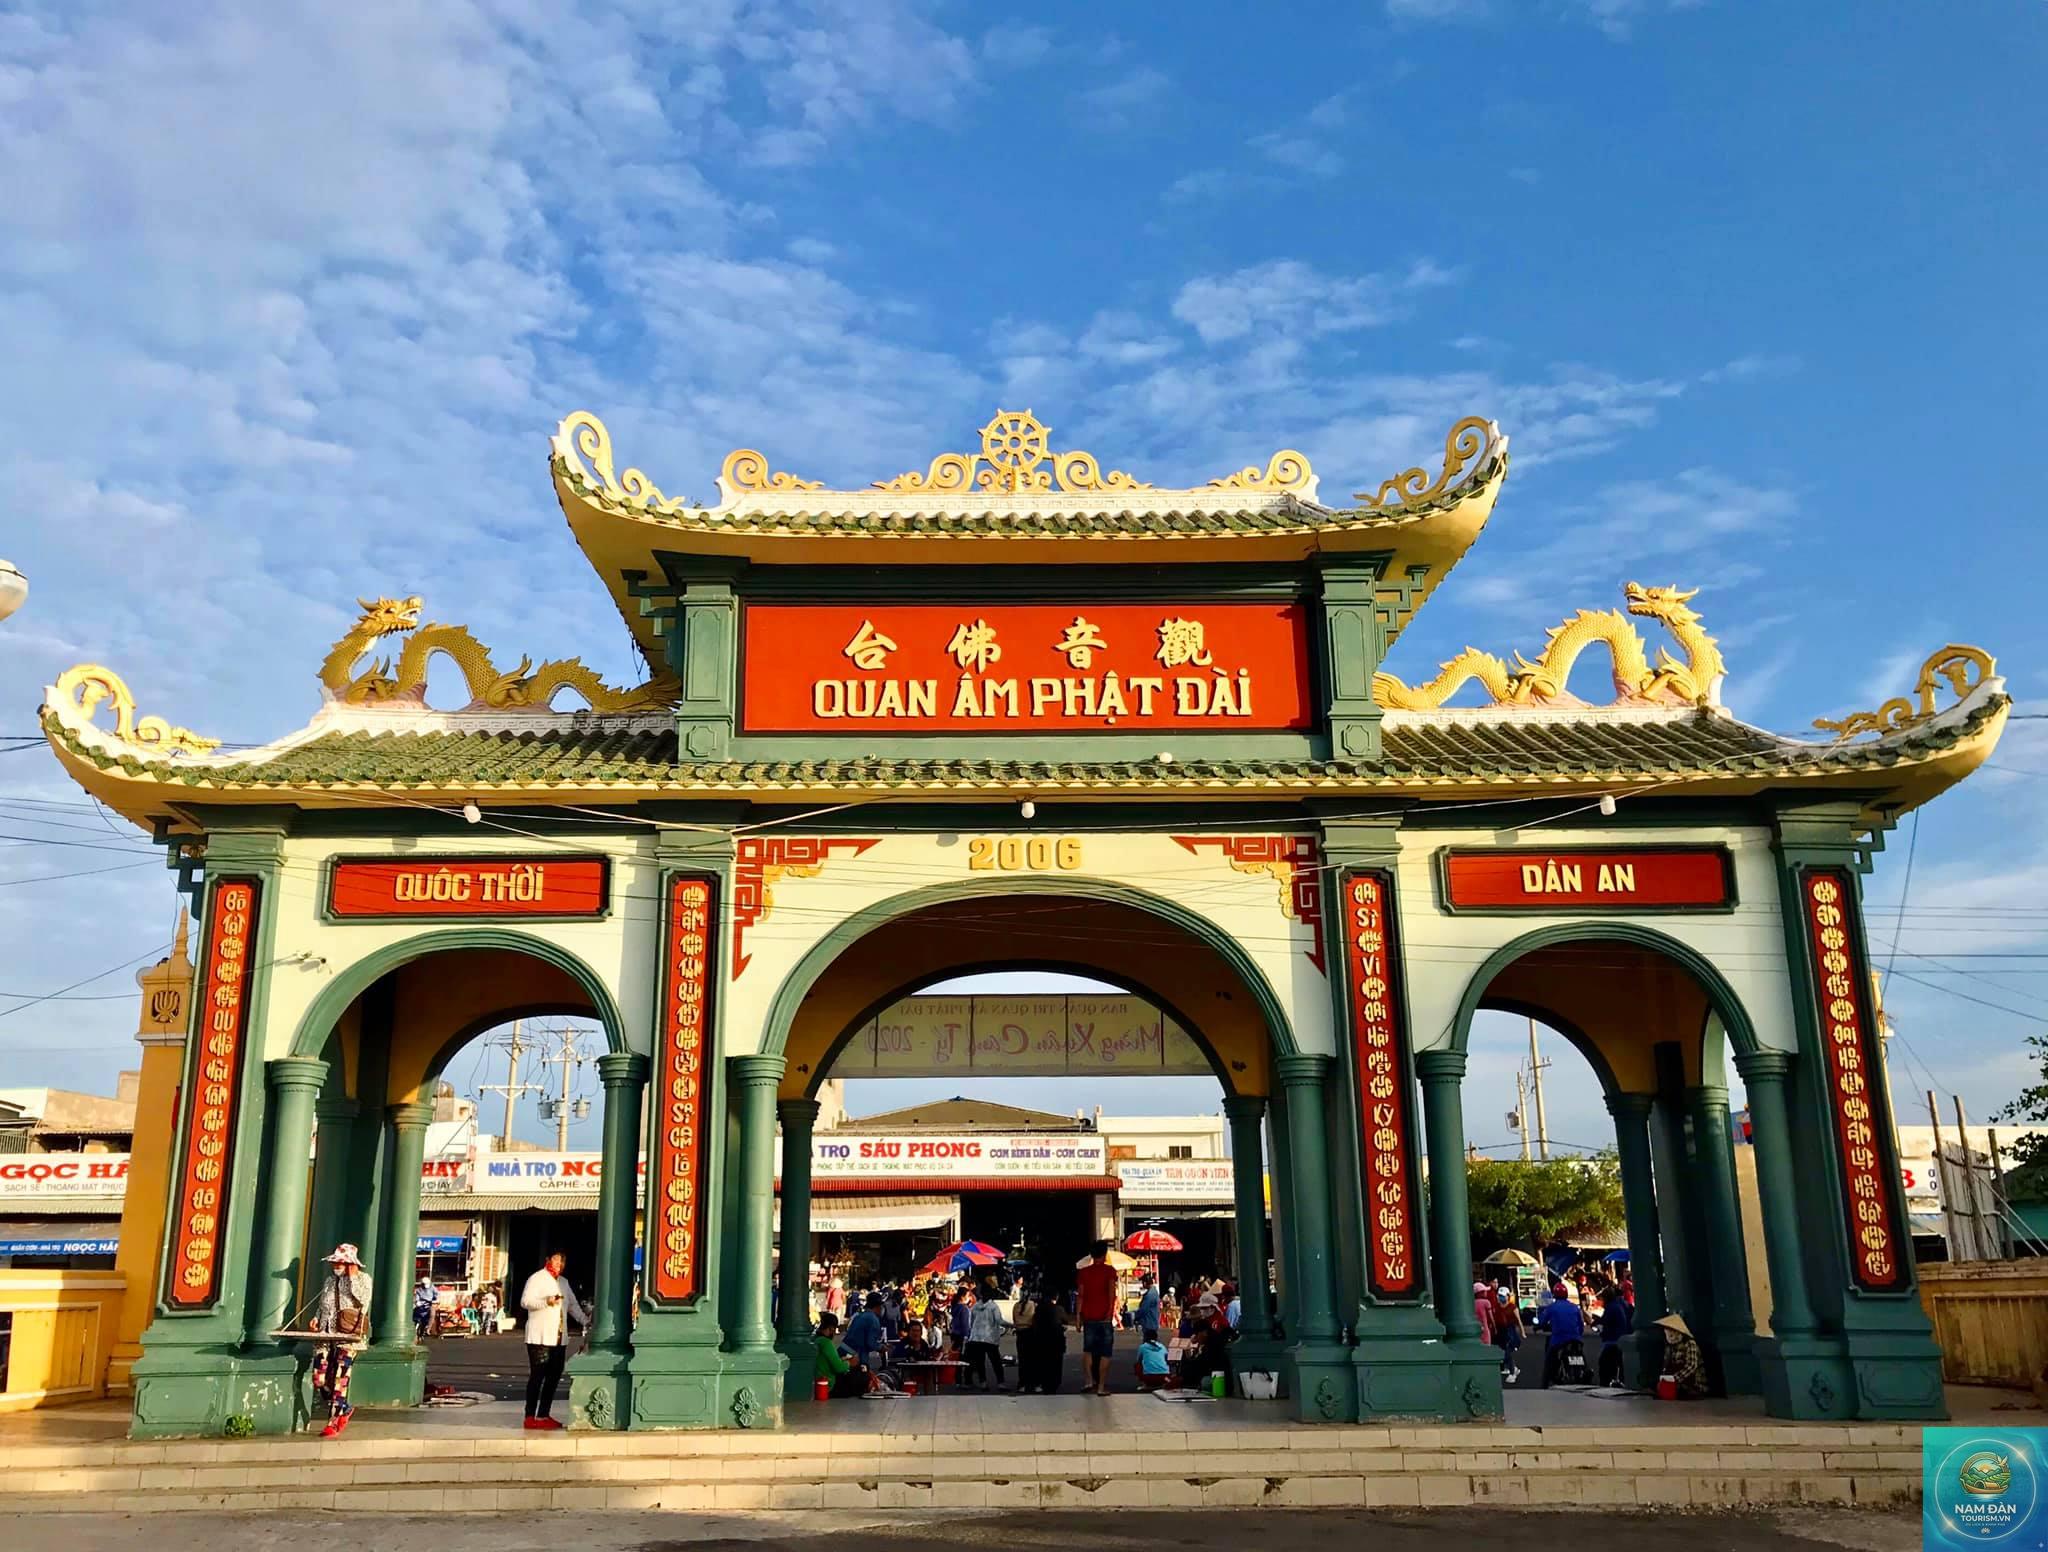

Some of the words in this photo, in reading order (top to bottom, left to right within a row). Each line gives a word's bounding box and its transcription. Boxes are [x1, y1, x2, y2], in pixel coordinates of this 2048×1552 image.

[814, 679, 938, 717] QUAN
[950, 671, 1020, 717] ÂM
[1031, 669, 1163, 725] PHẬT
[1176, 666, 1253, 716] ĐÀI
[969, 837, 1081, 870] 2006
[1522, 858, 1583, 892] DÂN
[1598, 863, 1636, 892] AN
[1355, 883, 1376, 903] ĐẠI
[682, 909, 704, 931] ÂM
[1363, 954, 1380, 976] VI
[1364, 1001, 1386, 1022] ĐẠI
[1833, 1025, 1856, 1045] ĐẠI
[670, 1126, 692, 1149] CAM
[818, 1144, 850, 1161] TRỌ
[859, 1138, 902, 1158] SÁU
[908, 1143, 982, 1158] PHONG
[1077, 1148, 1100, 1158] CHAY
[0, 1164, 79, 1183] GỌC
[421, 1161, 463, 1177] HAY
[488, 1158, 521, 1176] NHÀ
[525, 1162, 557, 1180] TRỌ
[193, 1187, 215, 1209] ĐỘ
[1378, 1181, 1401, 1204] TỨC
[1379, 1207, 1402, 1229] ĐẮC
[63, 1243, 96, 1253] NGỌC
[416, 1238, 431, 1248] ÂN
[1384, 1257, 1406, 1280] XỨ
